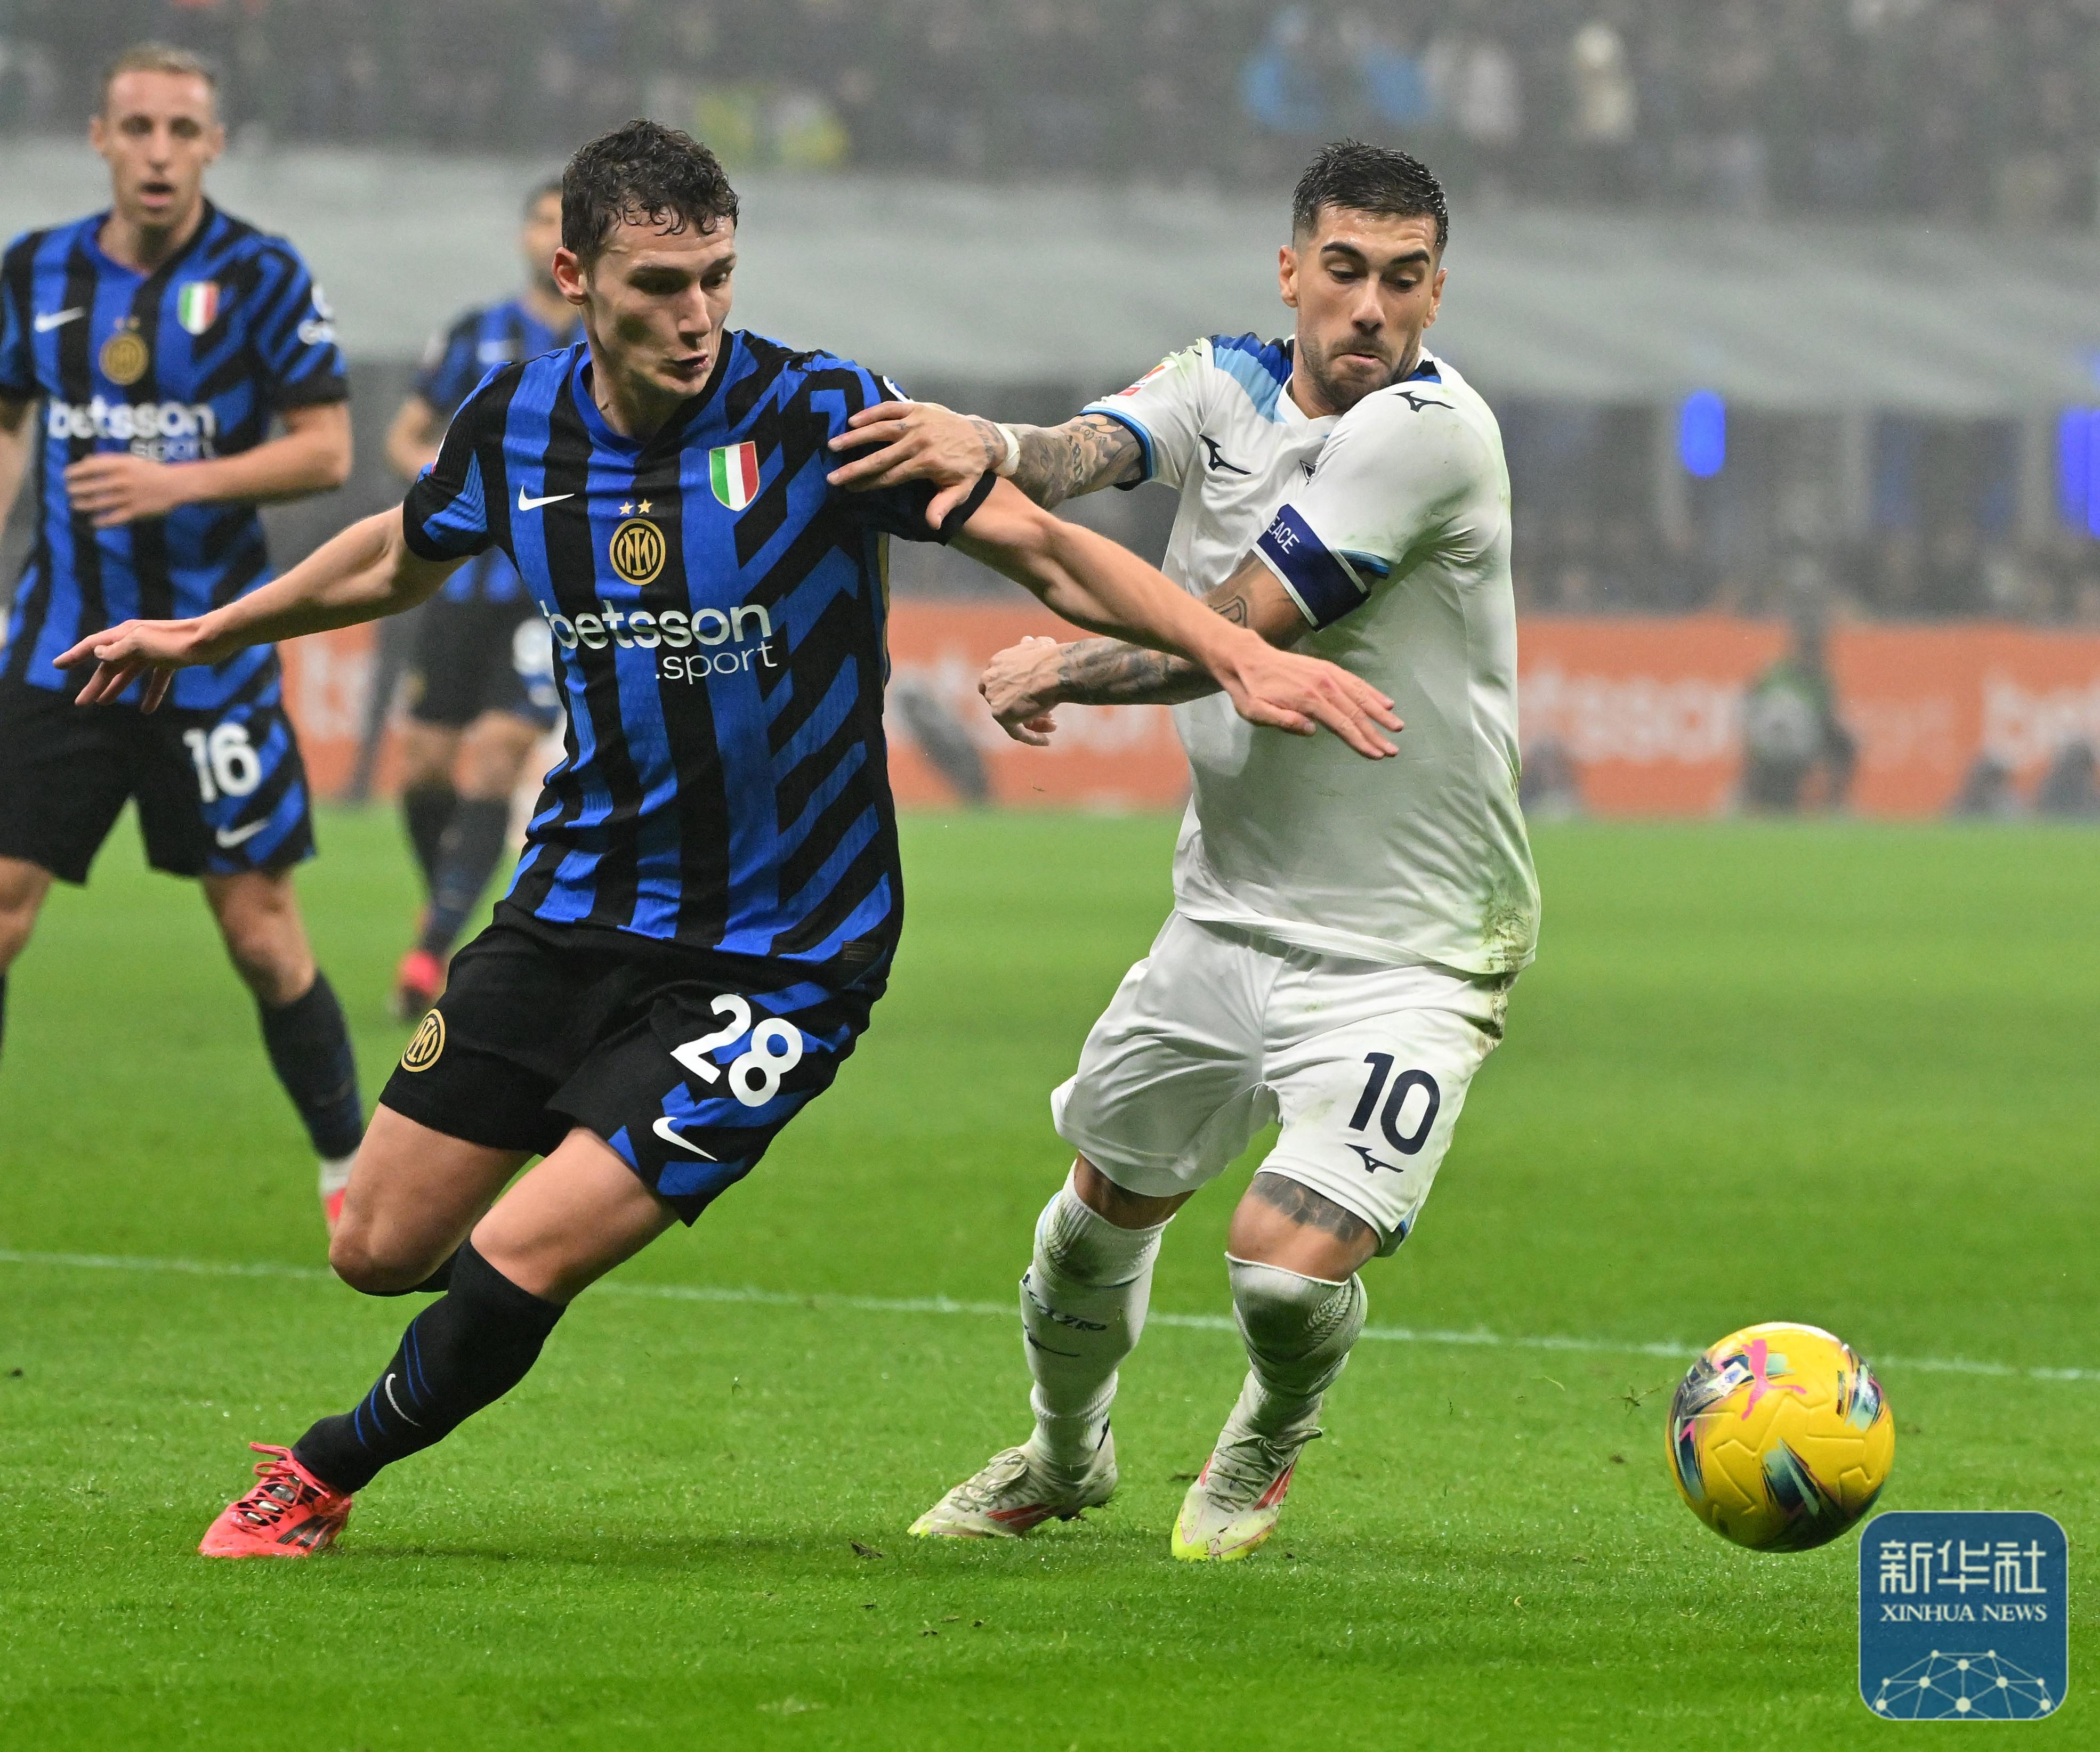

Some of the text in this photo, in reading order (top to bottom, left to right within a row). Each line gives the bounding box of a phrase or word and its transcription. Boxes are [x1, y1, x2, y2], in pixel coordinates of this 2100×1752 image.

[1266, 515, 1301, 555] EACE
[539, 600, 773, 650] betsson
[182, 722, 262, 802] 16
[670, 994, 803, 1107] 28
[1348, 1052, 1440, 1155] 10
